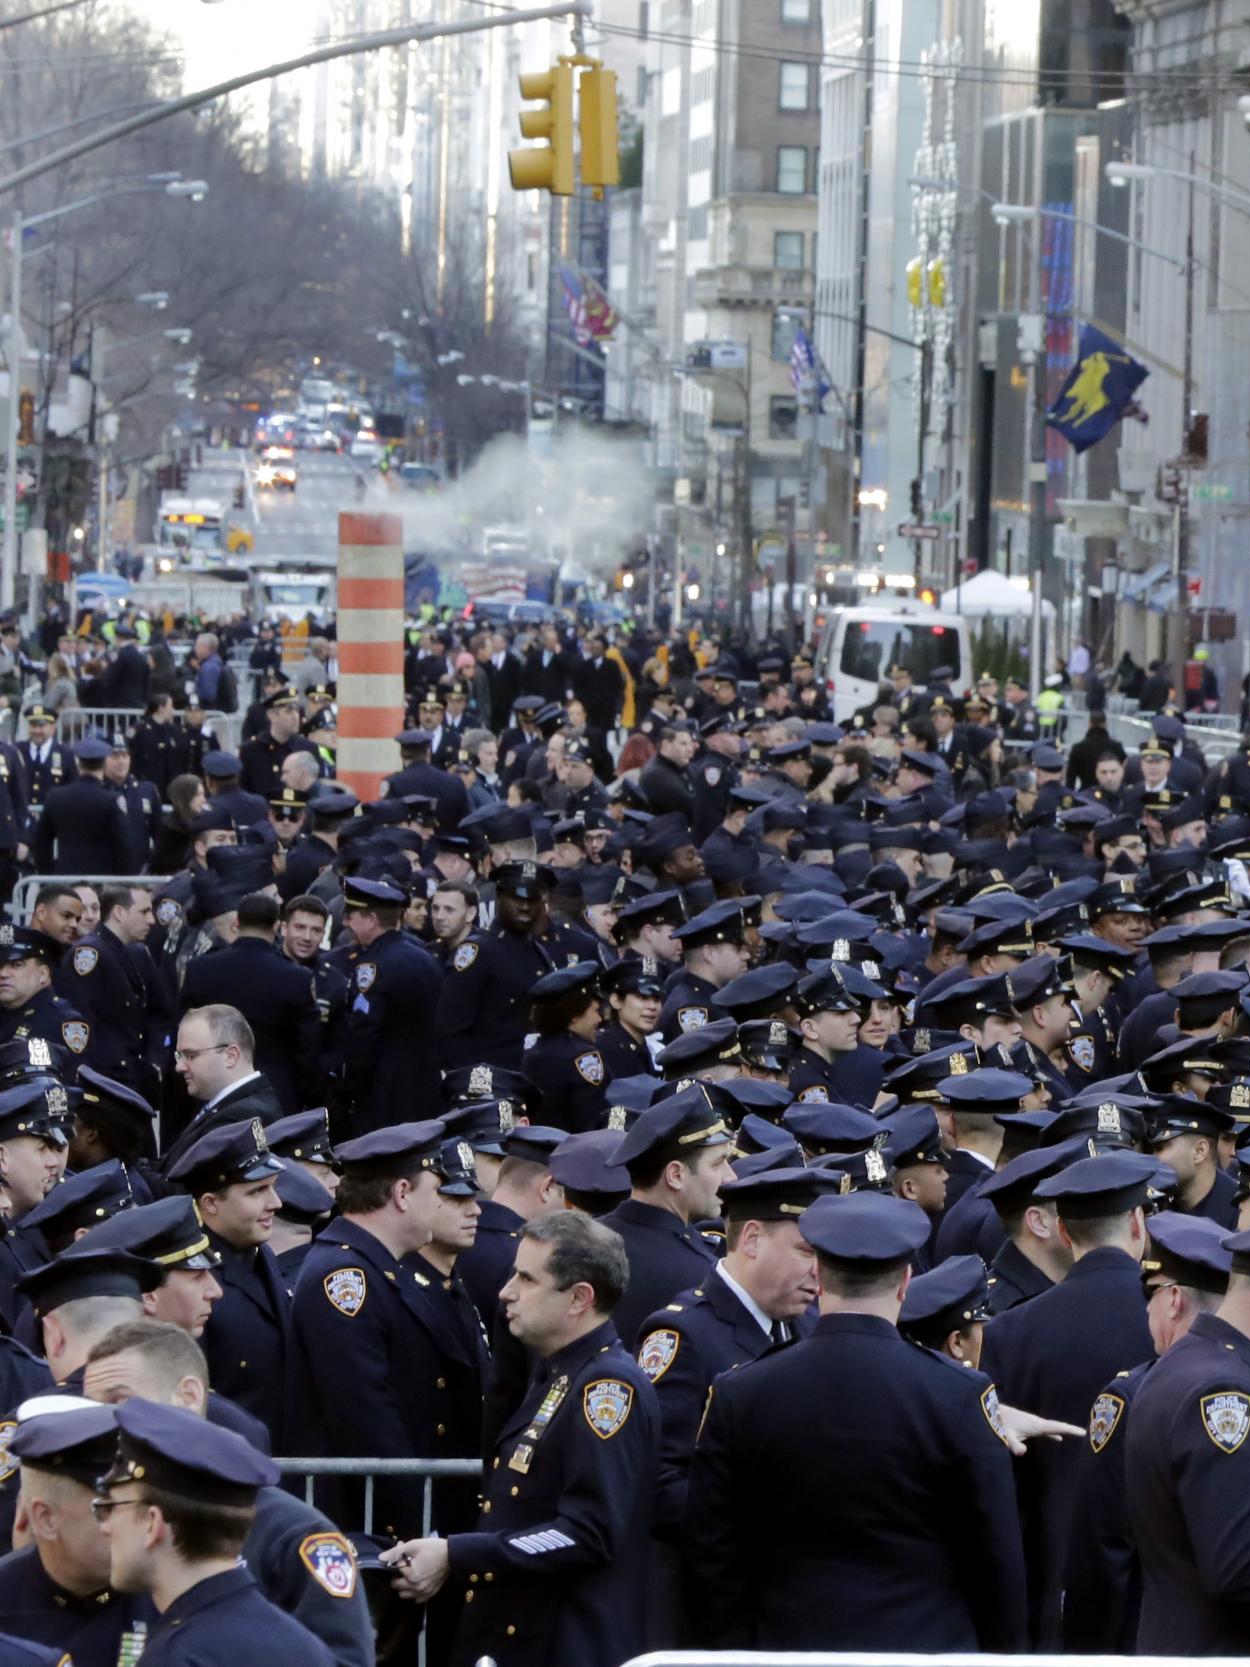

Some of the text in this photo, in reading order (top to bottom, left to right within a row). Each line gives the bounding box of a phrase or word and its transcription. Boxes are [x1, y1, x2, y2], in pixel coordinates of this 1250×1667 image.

[597, 1382, 620, 1391] POLICE
[588, 1388, 628, 1400] DEPARTMENT
[1214, 1395, 1239, 1405] POLICE
[1206, 1401, 1248, 1414] DEPARTMENT
